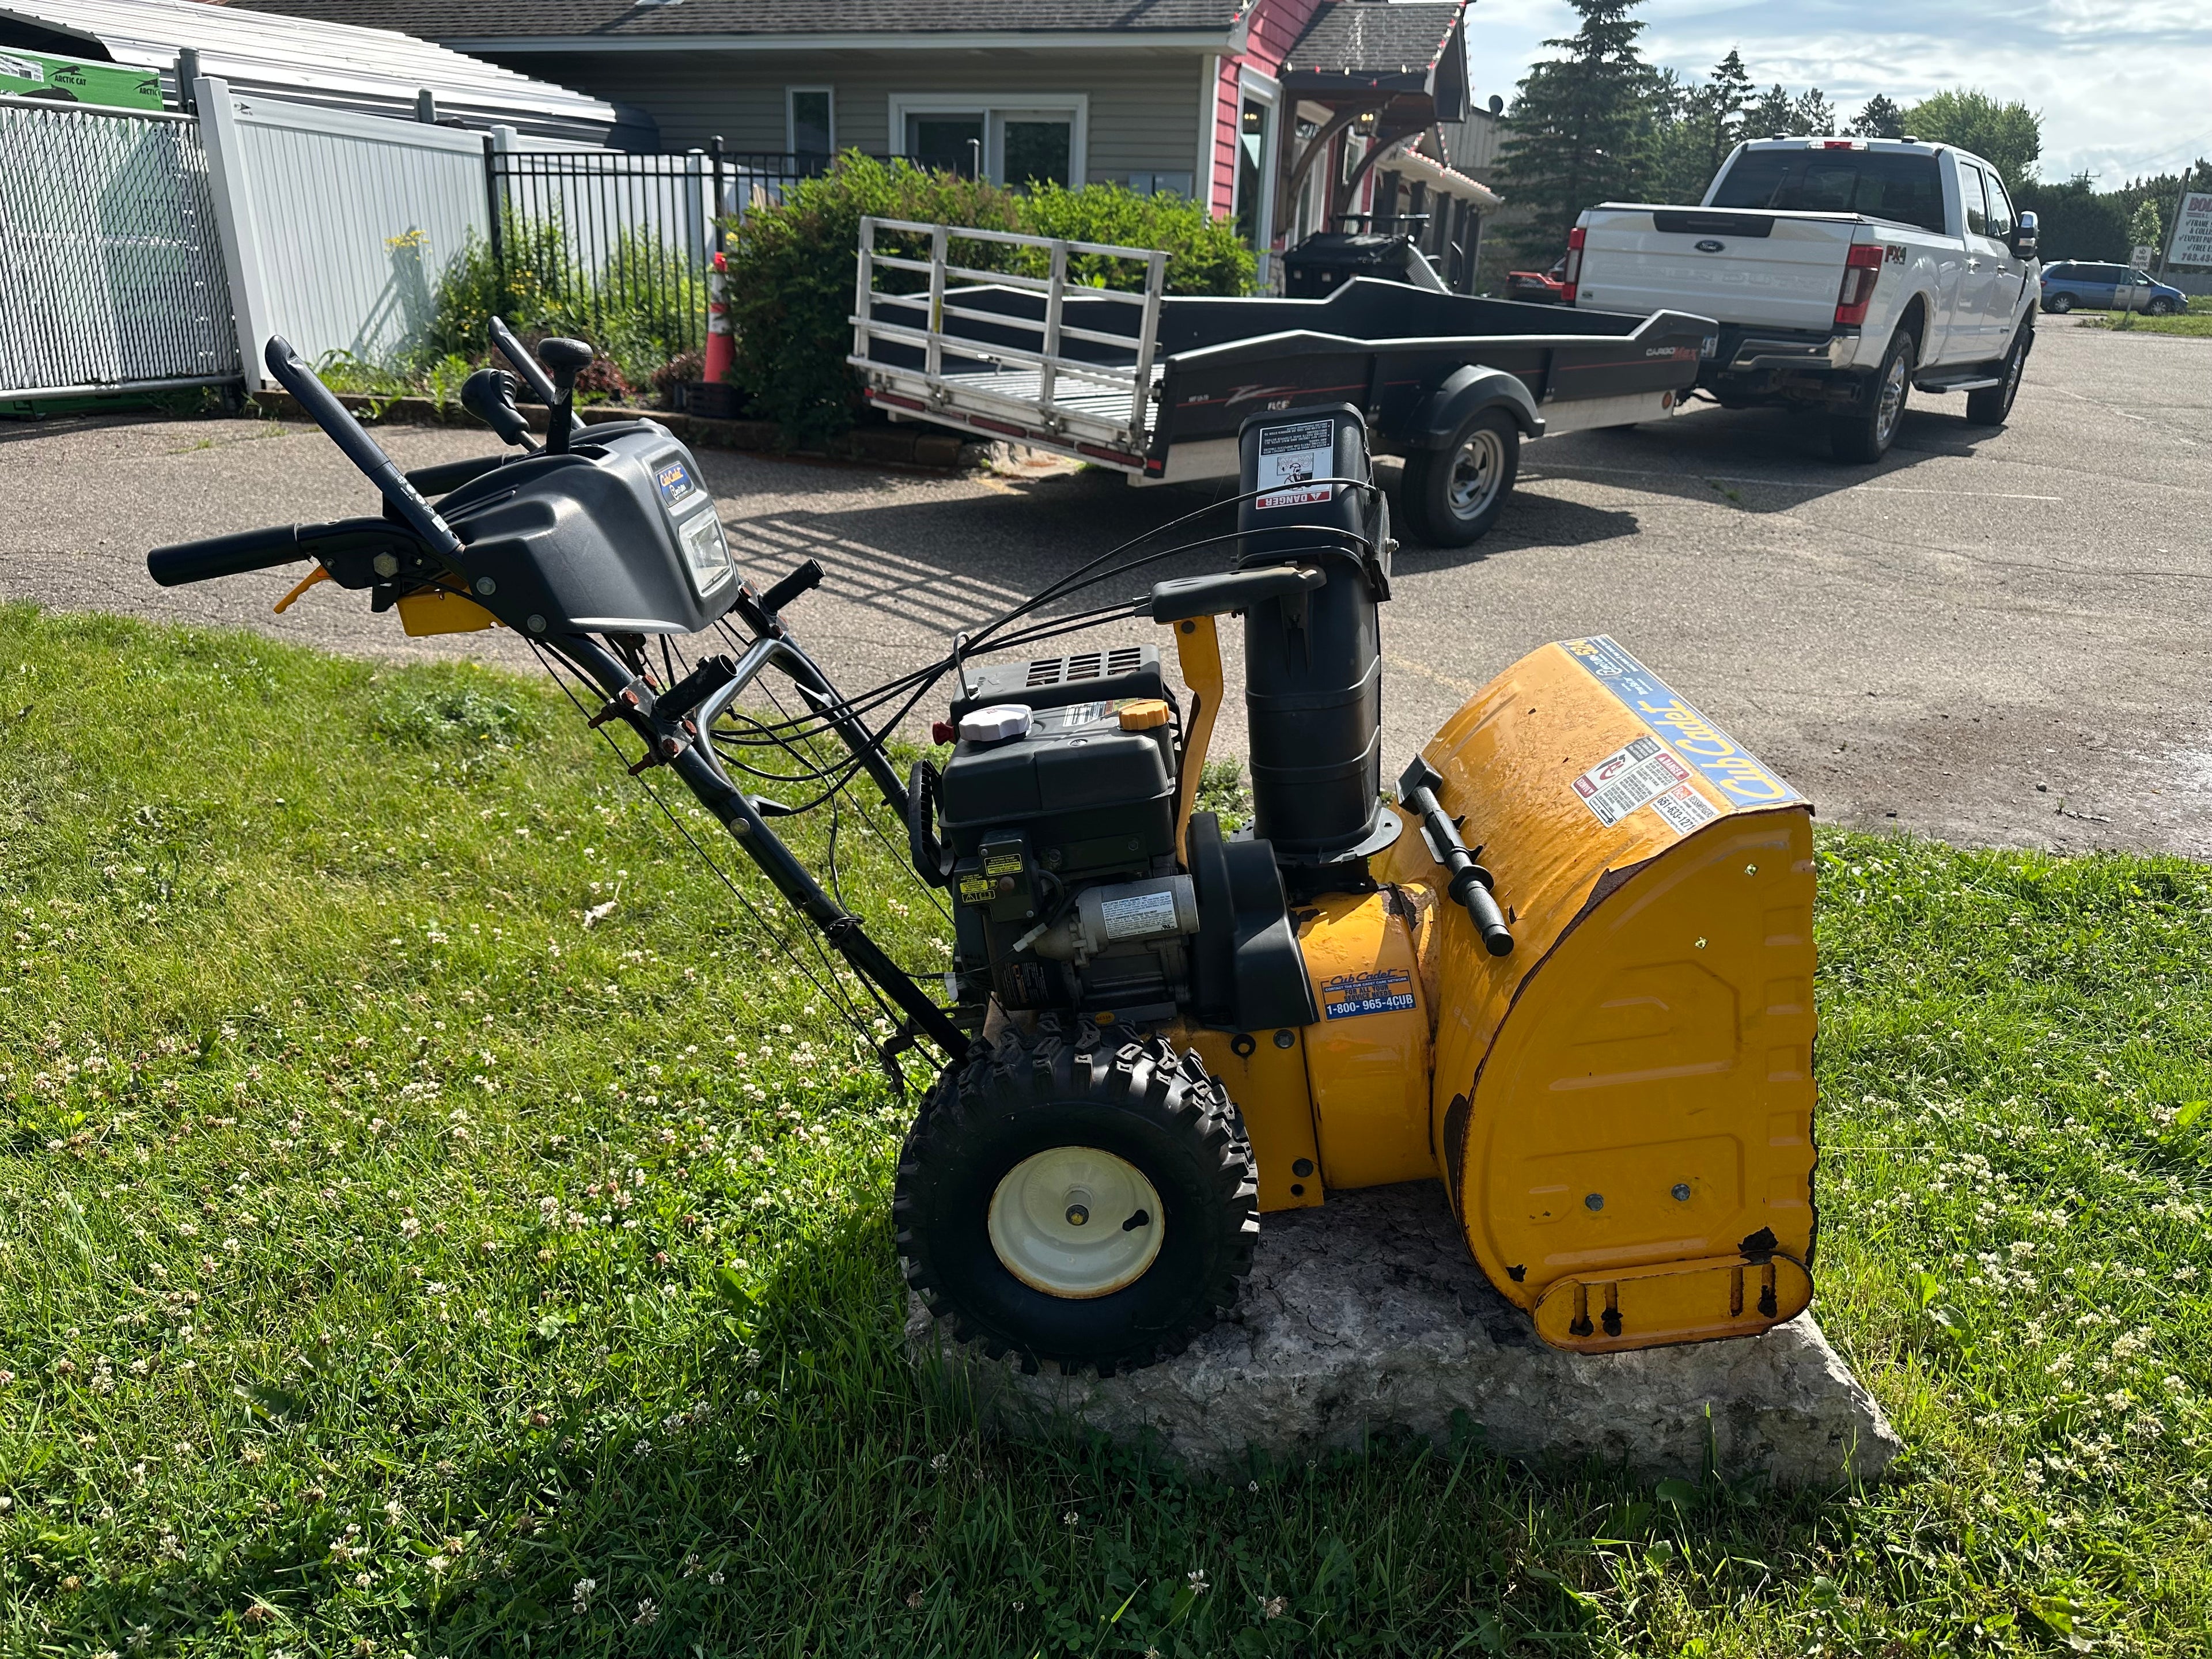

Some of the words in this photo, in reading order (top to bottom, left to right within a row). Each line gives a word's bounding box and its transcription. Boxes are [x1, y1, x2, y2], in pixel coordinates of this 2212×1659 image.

[55, 75, 74, 84] ARCTIC
[76, 78, 86, 86] CAT
[139, 88, 158, 96] ARCTIC
[2191, 219, 2209, 228] FRAME
[1884, 245, 1907, 263] FX4
[2192, 244, 2207, 252] FREE
[660, 473, 672, 487] Cub
[668, 467, 684, 483] Cadet
[1266, 494, 1308, 506] DANGER
[1637, 699, 1736, 756] Cadet
[1662, 758, 1684, 777] DANGER
[1700, 757, 1786, 798] Cub
[1577, 779, 1592, 794] DANGER
[1657, 797, 1696, 831] 651-633-1271
[1330, 974, 1354, 985] Cub
[1356, 969, 1397, 982] Cadet
[1344, 993, 1370, 1001] SERVICE
[1362, 994, 1413, 1010] 965-4CUB
